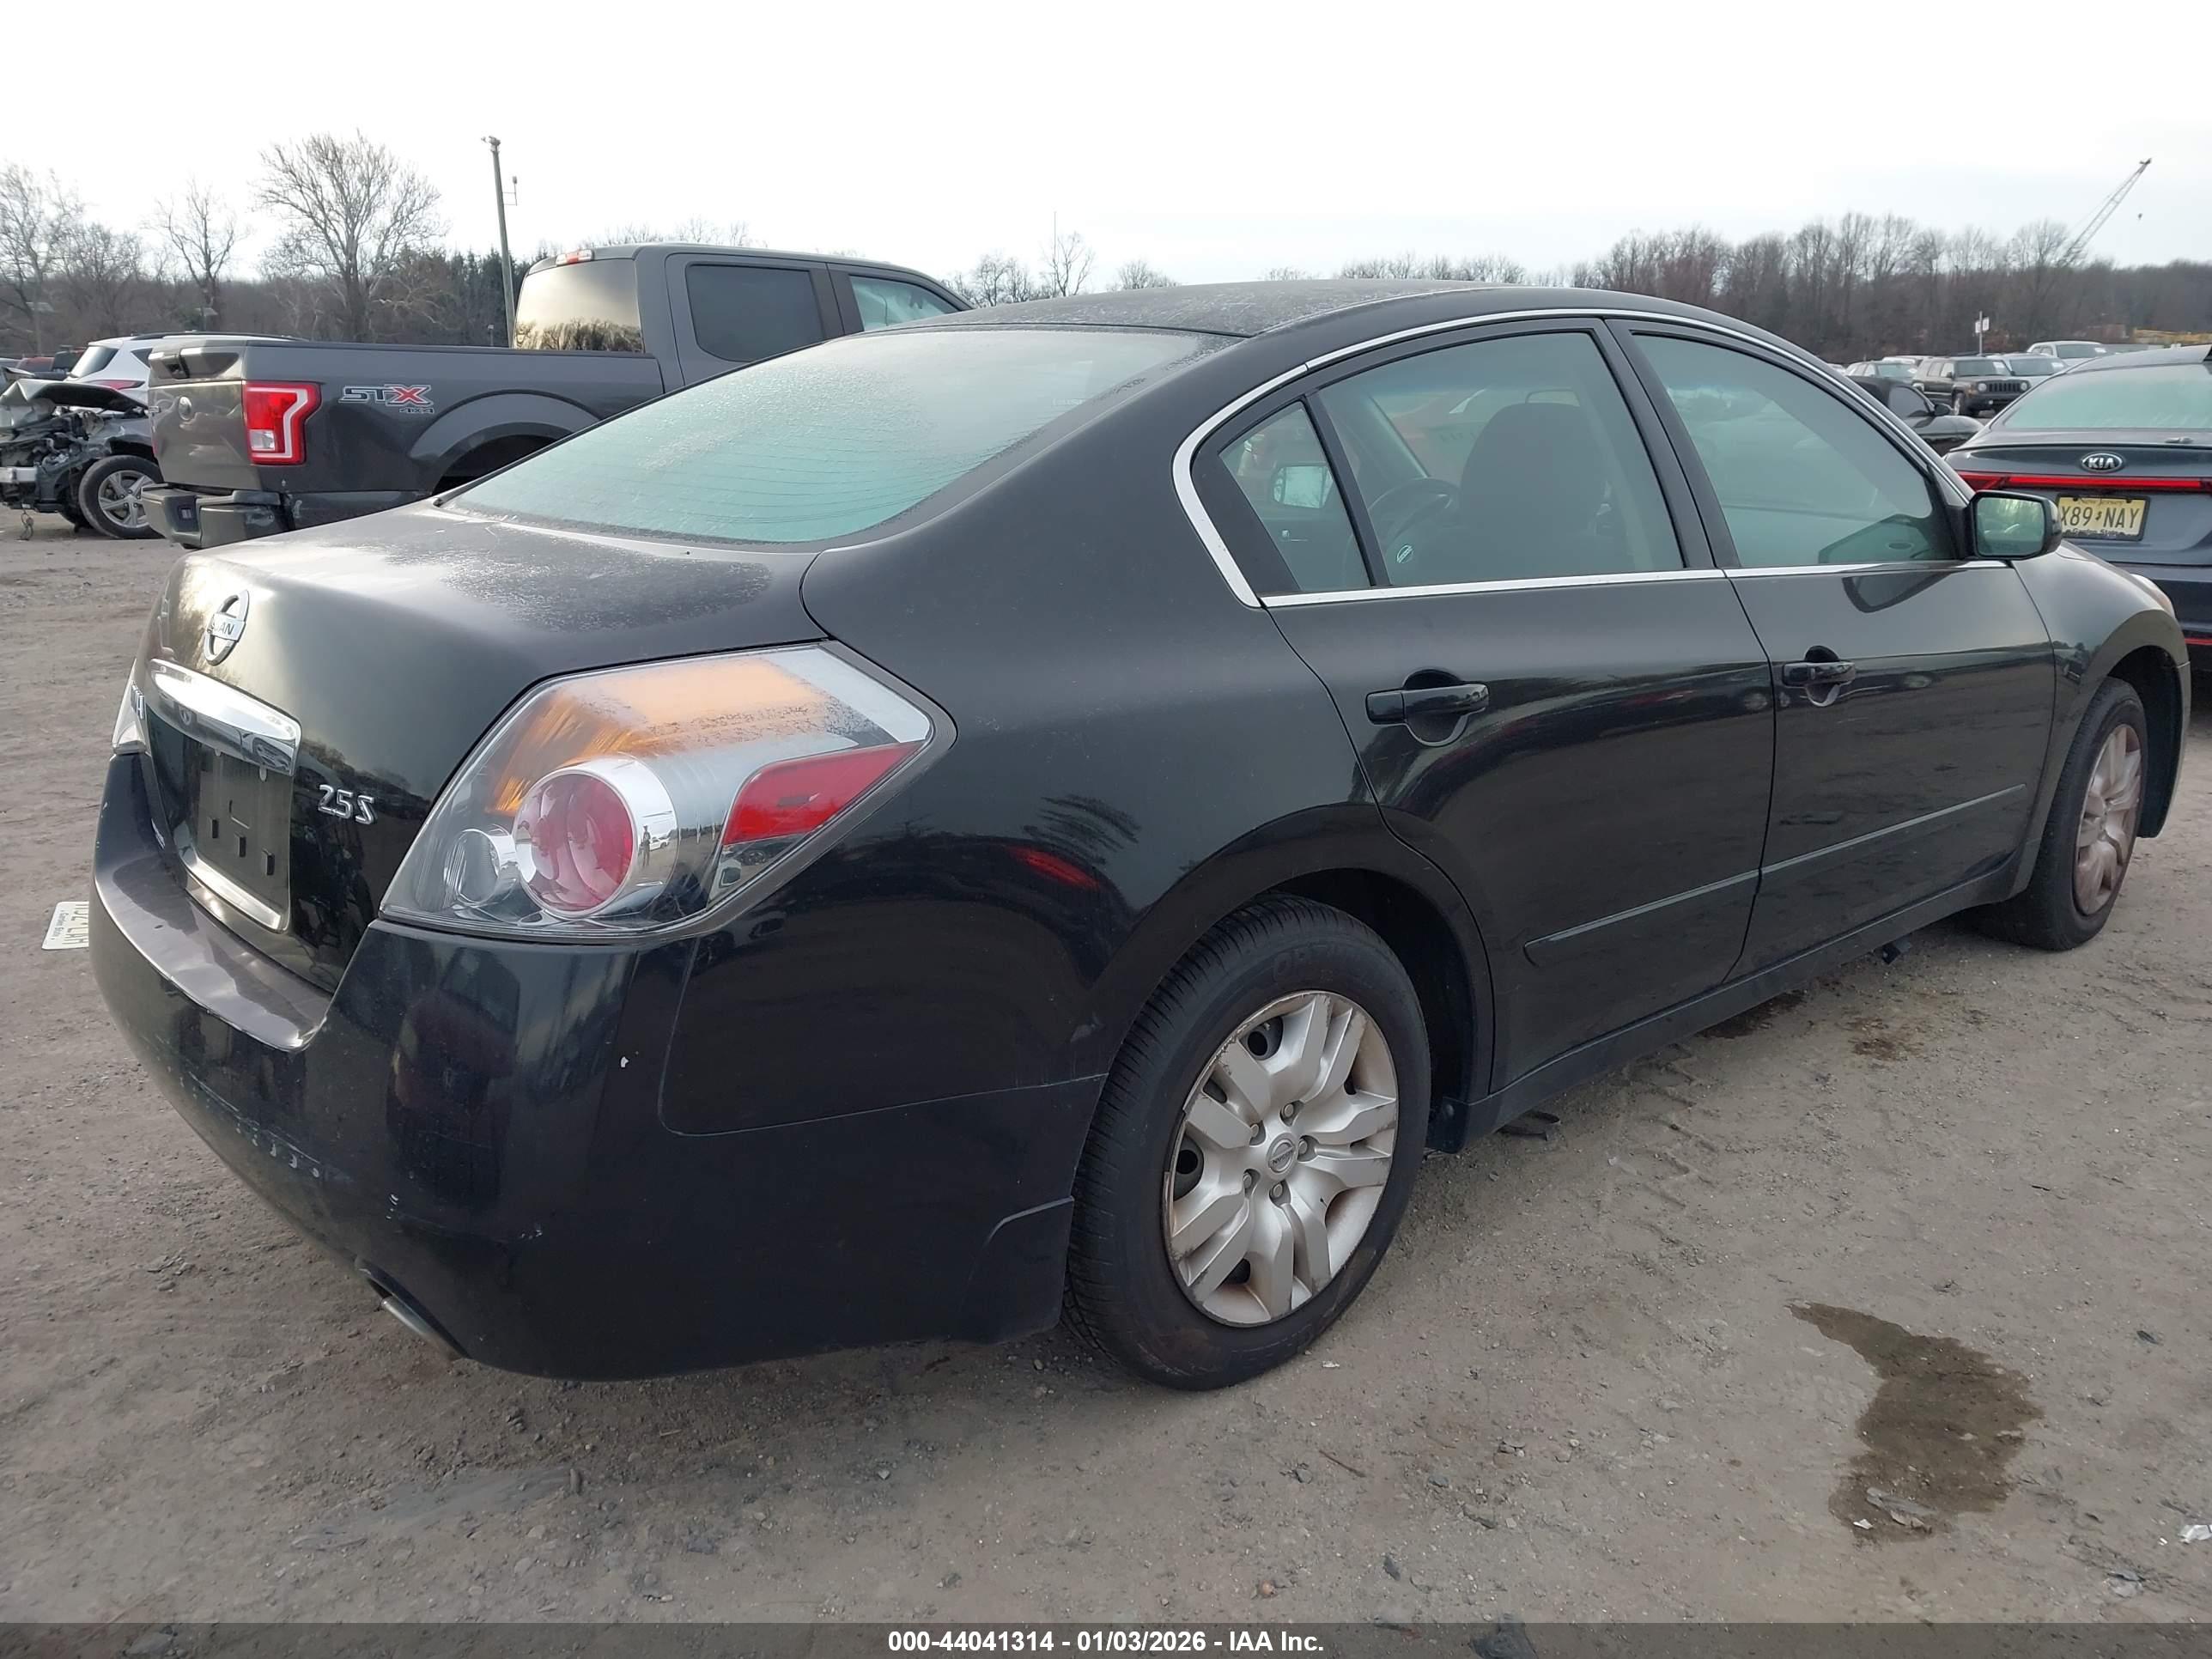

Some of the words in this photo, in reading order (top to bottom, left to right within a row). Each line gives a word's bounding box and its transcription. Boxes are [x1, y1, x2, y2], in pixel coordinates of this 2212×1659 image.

[337, 383, 434, 407] STX
[2087, 457, 2116, 469] KIA
[2061, 506, 2094, 526] X89
[2103, 507, 2139, 528] NAY
